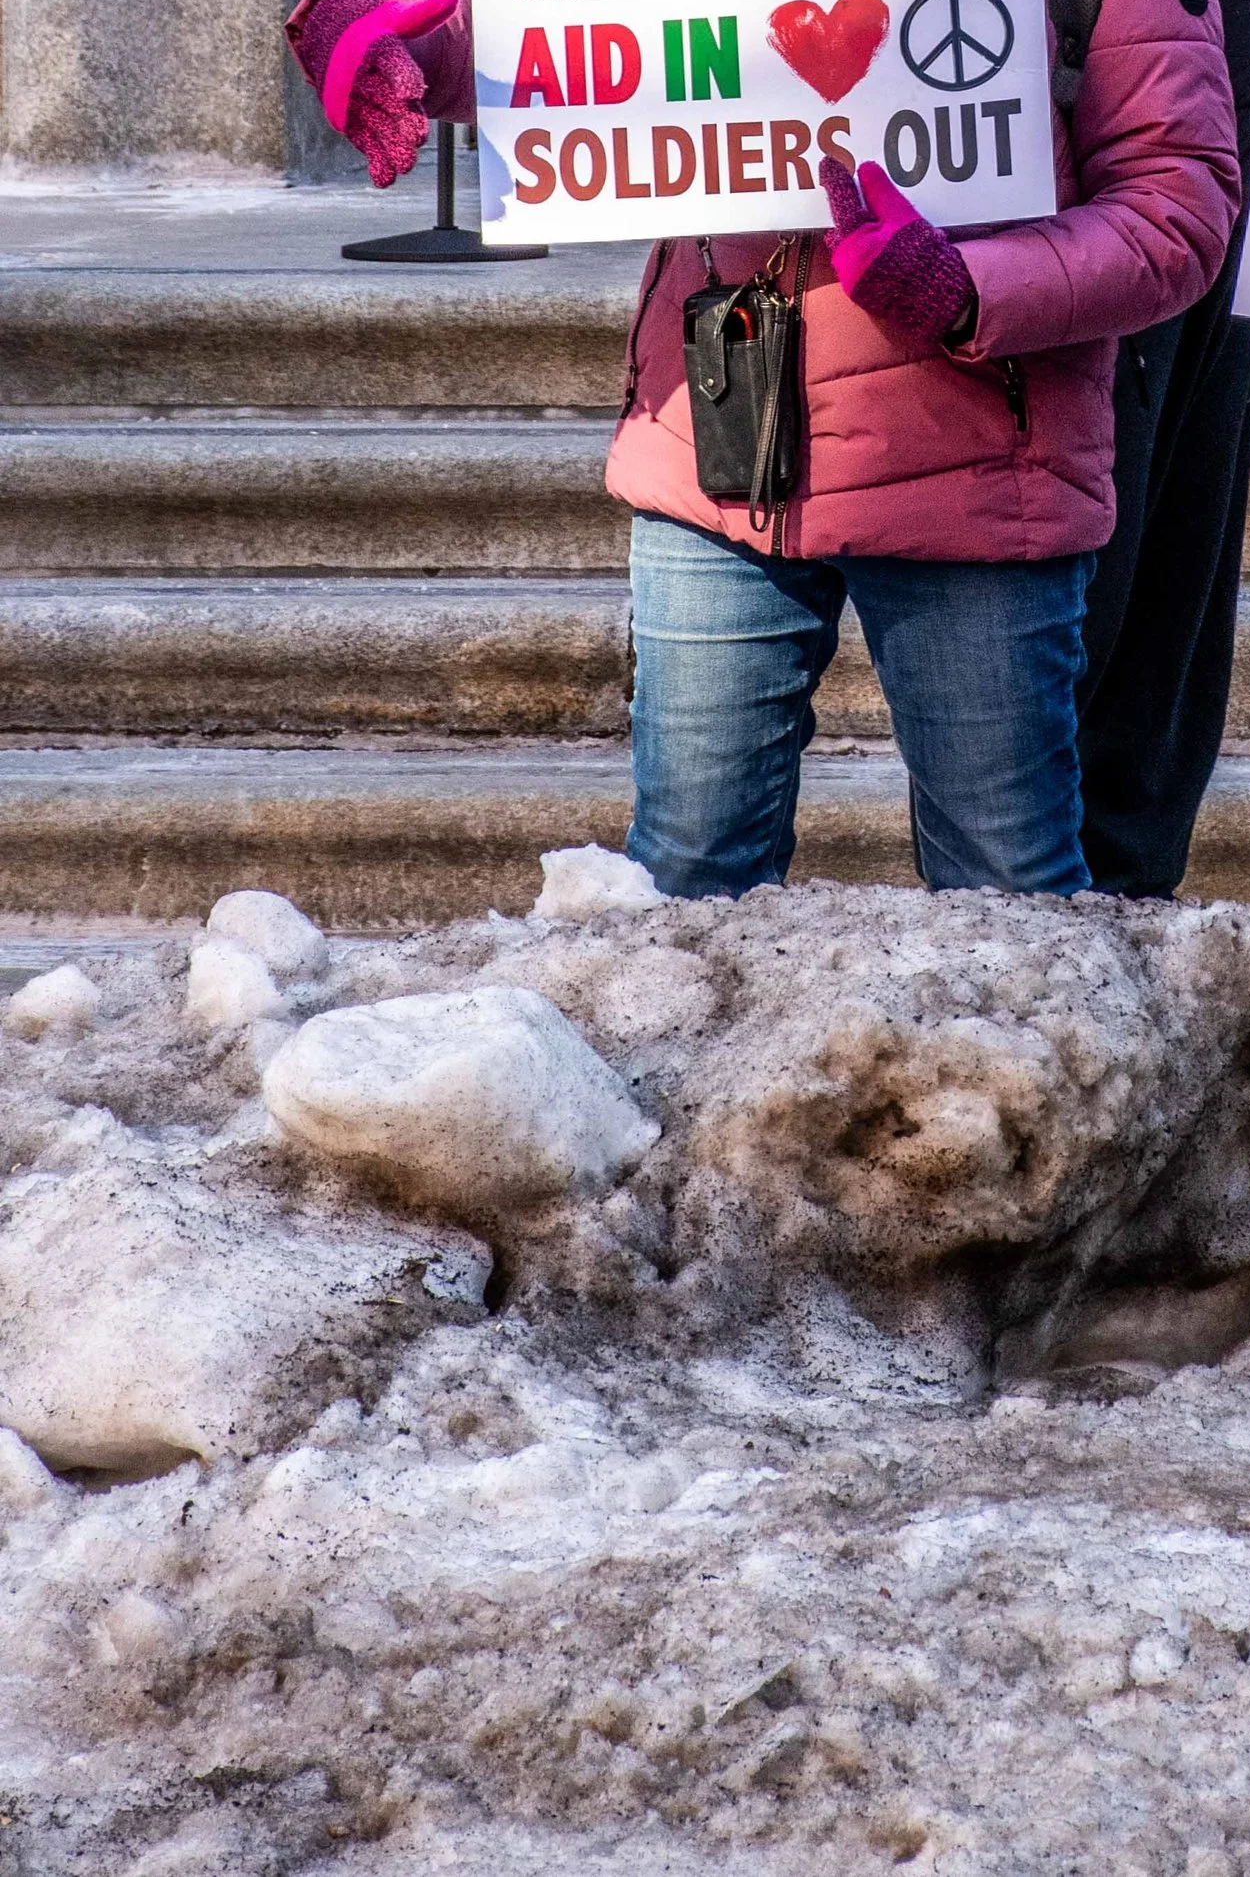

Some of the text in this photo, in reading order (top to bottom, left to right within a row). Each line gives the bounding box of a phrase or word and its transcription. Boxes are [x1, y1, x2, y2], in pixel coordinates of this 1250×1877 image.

[509, 15, 742, 109] AID IN
[514, 98, 1022, 204] SOLDIERS OUT
